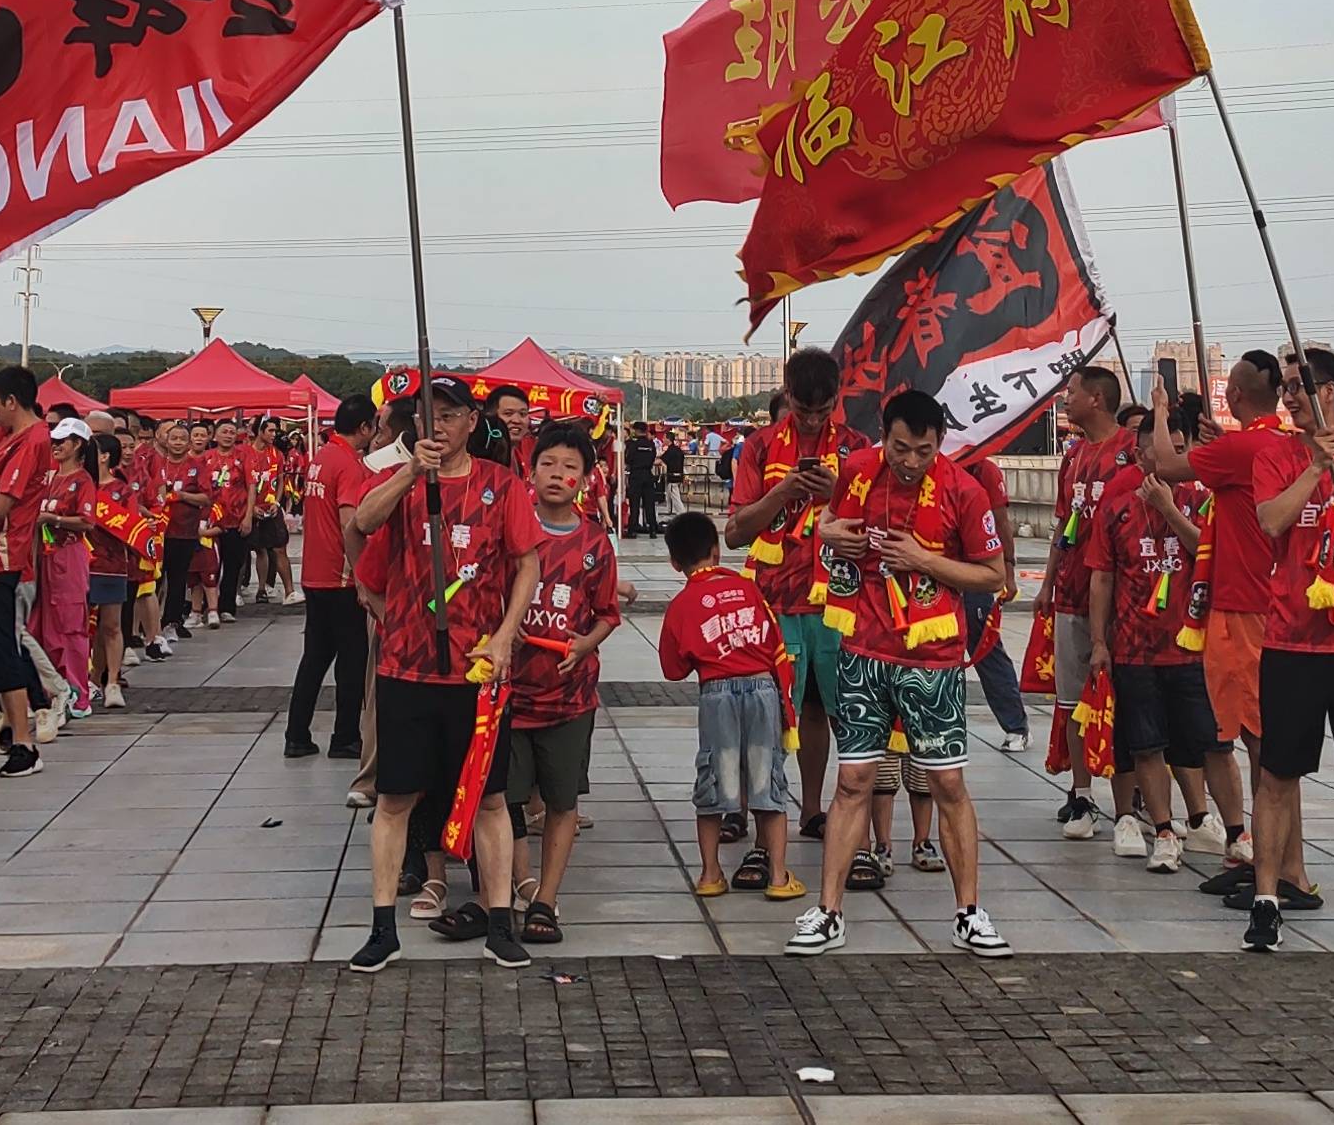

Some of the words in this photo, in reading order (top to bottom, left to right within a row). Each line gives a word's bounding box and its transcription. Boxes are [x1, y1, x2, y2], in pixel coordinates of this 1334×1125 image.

[1142, 559, 1183, 573] JXC
[523, 609, 568, 630] JXYC
[700, 606, 756, 643] 看球赛
